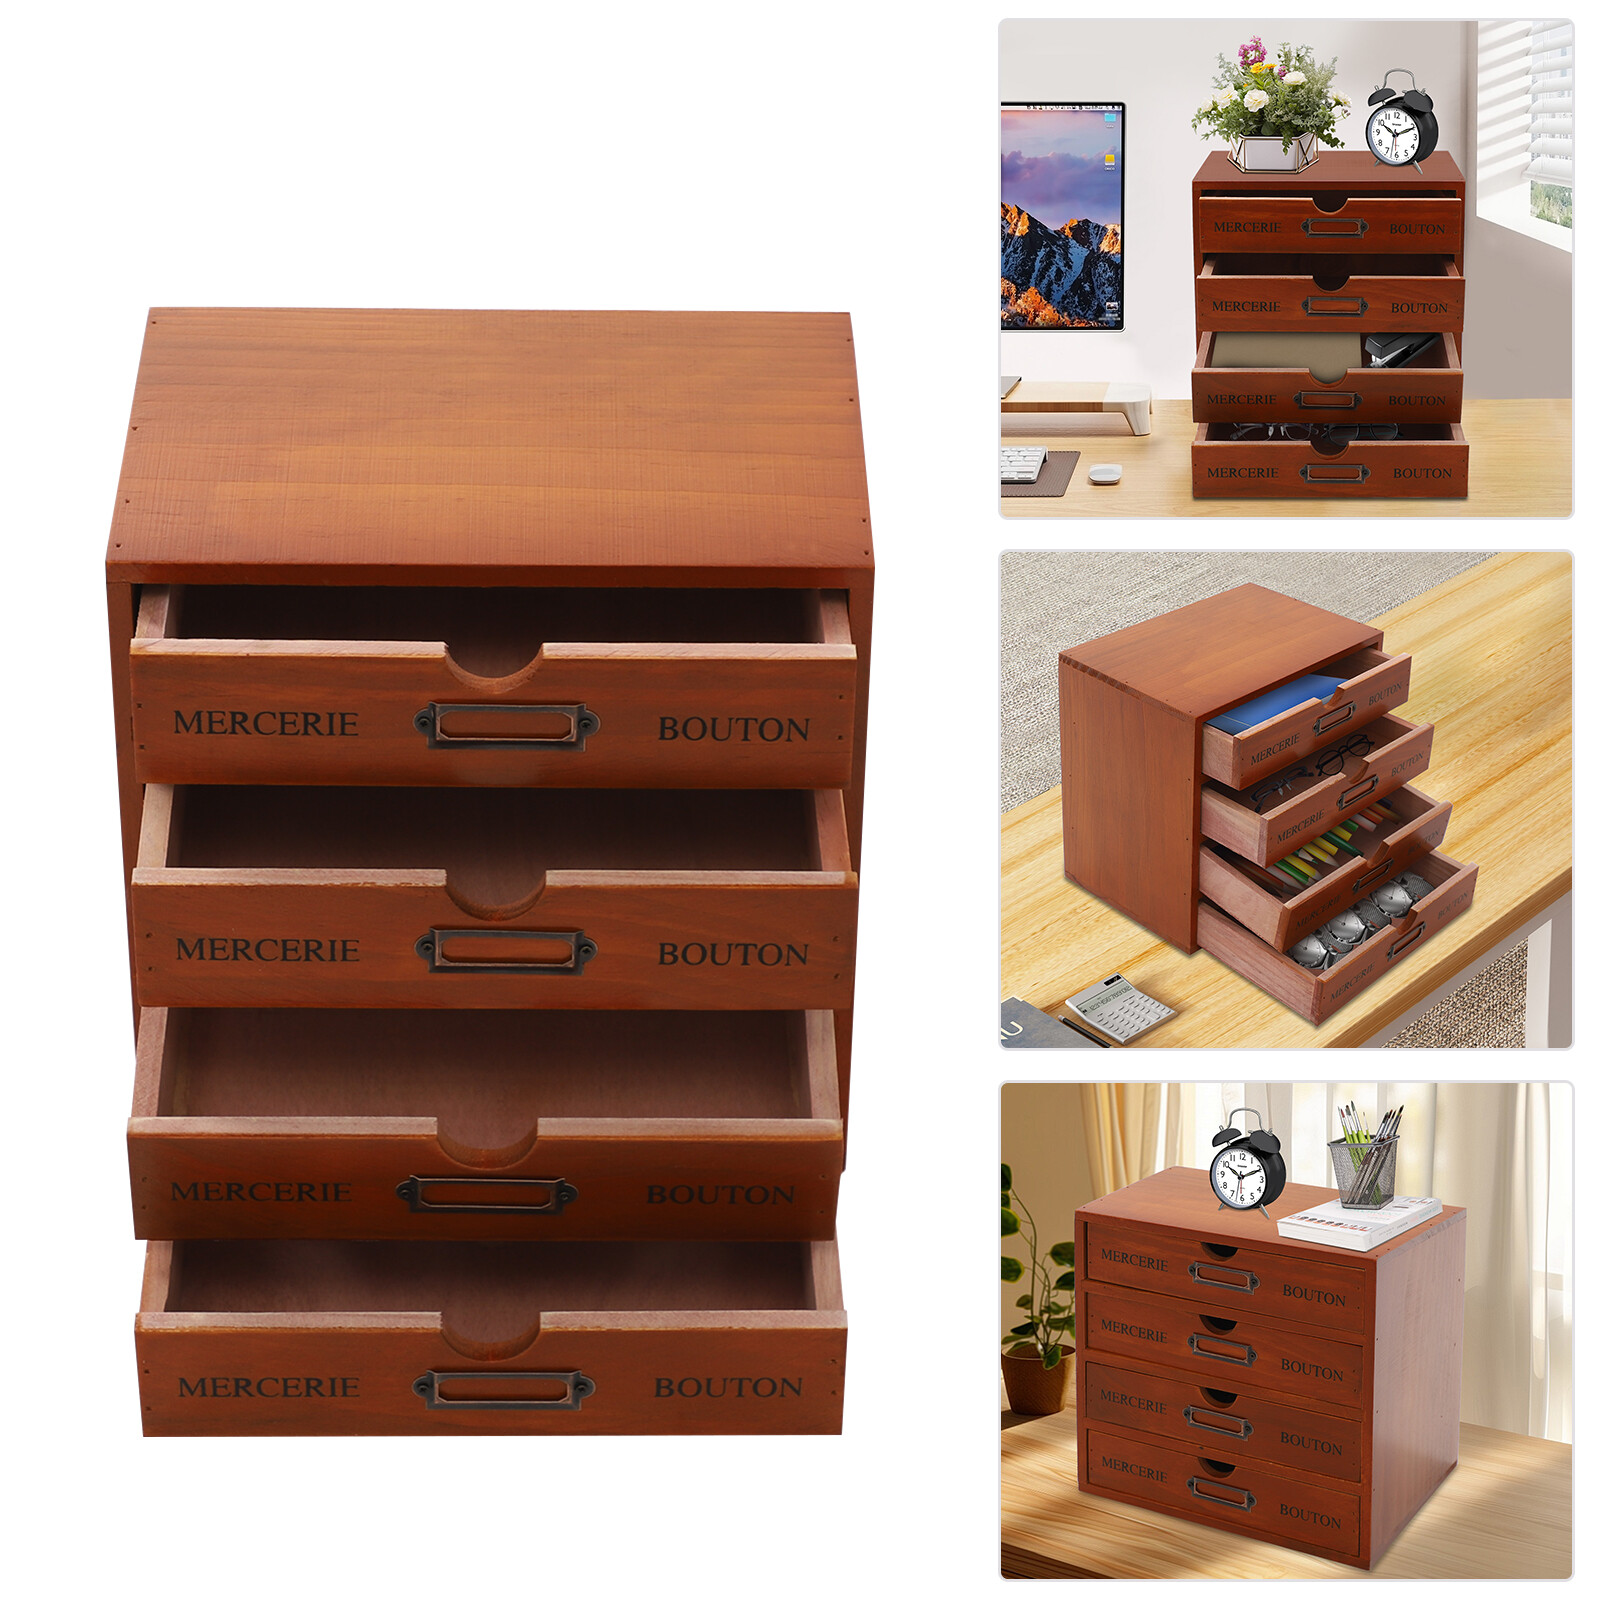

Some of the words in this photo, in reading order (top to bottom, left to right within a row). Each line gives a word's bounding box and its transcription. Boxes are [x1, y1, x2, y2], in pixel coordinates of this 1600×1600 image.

[1214, 222, 1282, 234] MERCERIE
[1390, 223, 1445, 235] BOUTON
[1212, 300, 1280, 312] MERCERIE
[1391, 302, 1448, 314] BOUTON
[1207, 394, 1276, 405] MERCERIE
[1389, 395, 1446, 406] BOUTON
[1208, 467, 1279, 479] MERCERIE
[1394, 468, 1452, 480] BOUTON
[173, 710, 359, 738] MERCERIE
[658, 716, 810, 743] BOUTON
[1250, 732, 1300, 766] MERCERIE
[1368, 682, 1402, 706] BOUTON
[1277, 808, 1325, 844] MERCERIE
[1391, 752, 1424, 777] BOUTON
[175, 937, 360, 963] MERCERIE
[658, 942, 809, 968] BOUTON
[170, 1181, 352, 1203] MERCERIE
[646, 1183, 795, 1206] BOUTON
[1101, 1248, 1169, 1273] MERCERIE
[1283, 1284, 1346, 1308] BOUTON
[1101, 1318, 1168, 1344] MERCERIE
[1281, 1358, 1343, 1382] BOUTON
[177, 1376, 360, 1399] MERCERIE
[654, 1376, 803, 1399] BOUTON
[1100, 1389, 1167, 1415] MERCERIE
[1280, 1432, 1342, 1456] BOUTON
[1102, 1456, 1168, 1484] MERCERIE
[1280, 1503, 1342, 1529] BOUTON
